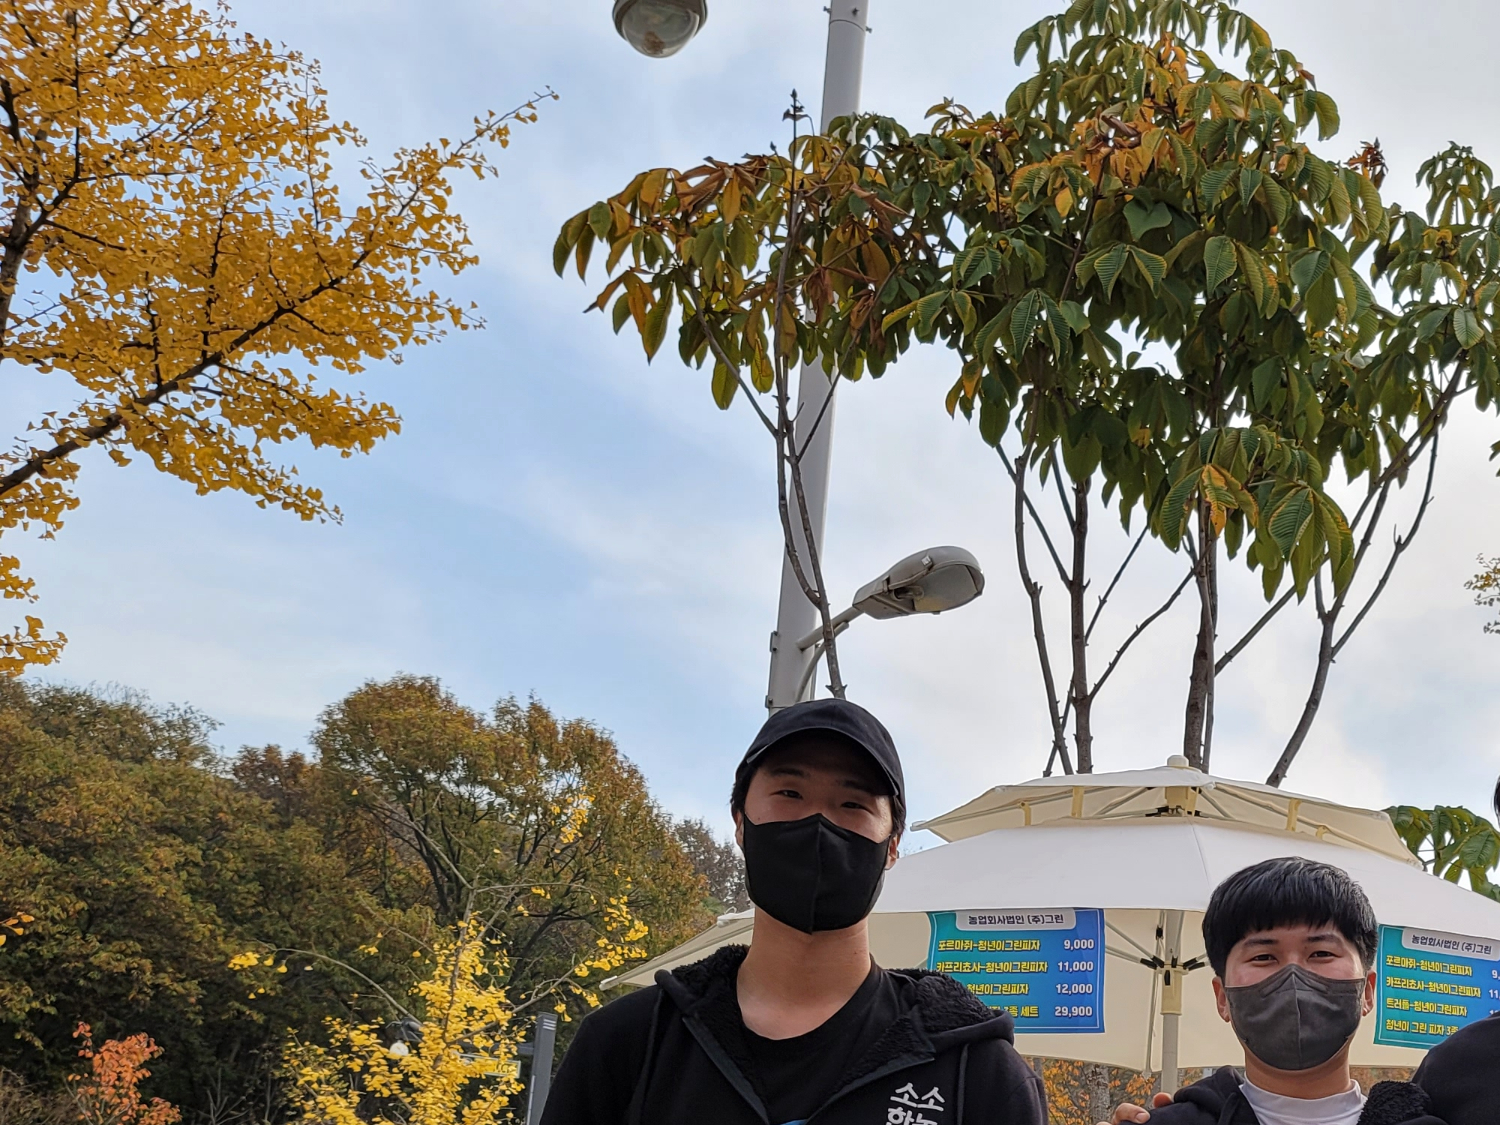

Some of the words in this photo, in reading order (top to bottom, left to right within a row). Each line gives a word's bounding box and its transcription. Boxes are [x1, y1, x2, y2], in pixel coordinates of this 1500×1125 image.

[968, 914, 1025, 925] 농업회사법인
[1027, 914, 1064, 925] (주)그린
[1063, 939, 1094, 950] 9,000
[1411, 935, 1459, 949] 농업회사법인
[1461, 942, 1492, 955] (주)그린
[1057, 962, 1094, 972] 11,000
[1056, 984, 1093, 995] 12,000
[1021, 1006, 1038, 1017] 세트
[1055, 1006, 1093, 1017] 29,900
[1386, 1019, 1409, 1032] 청년이
[1411, 1022, 1427, 1033] 그린
[1429, 1024, 1445, 1035] 피자
[890, 1082, 945, 1112] 소소
